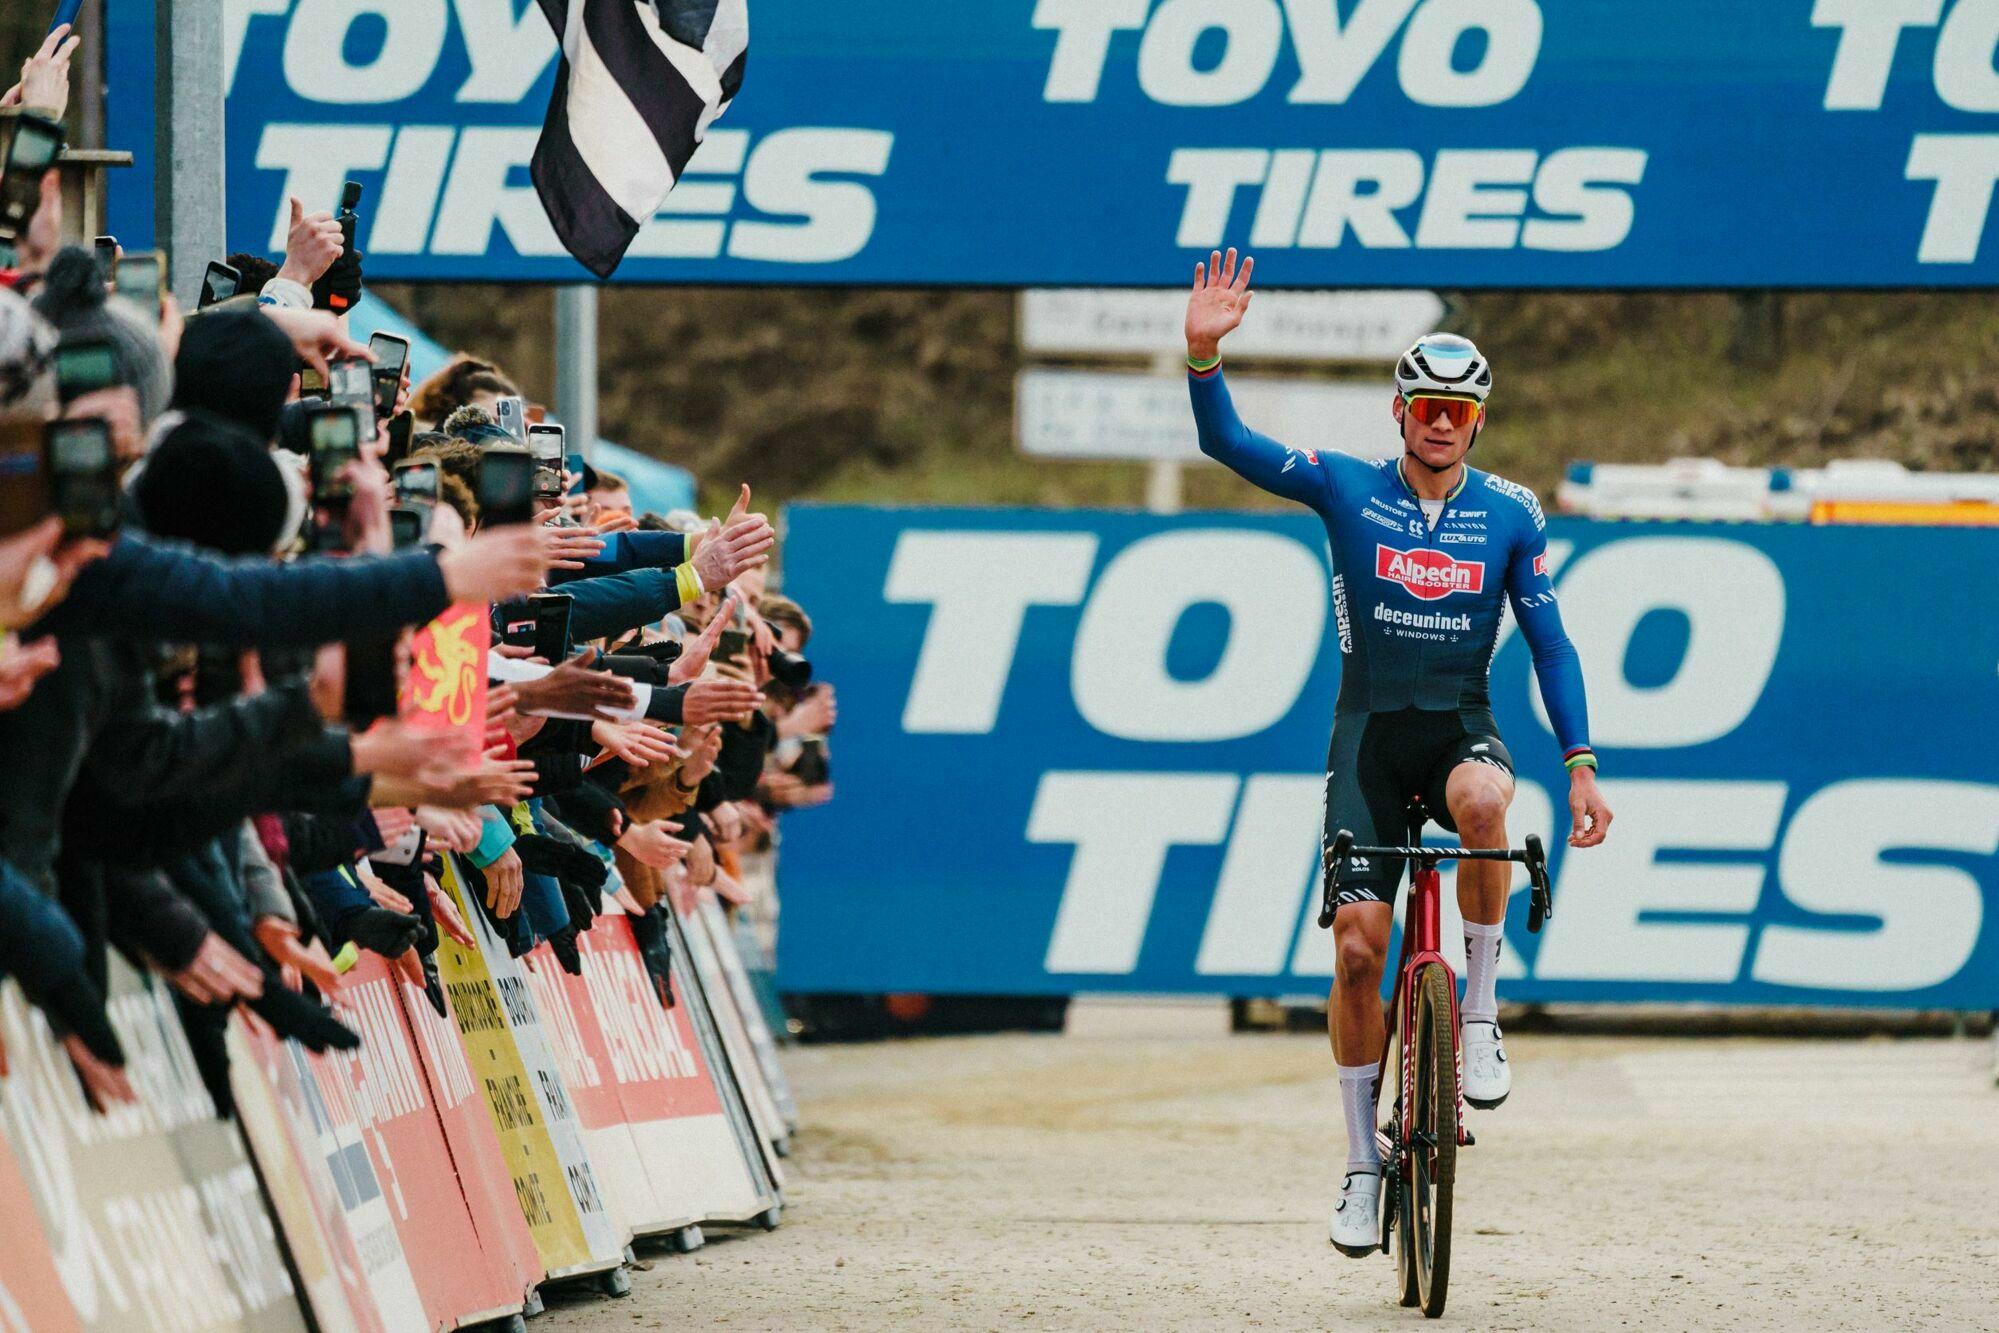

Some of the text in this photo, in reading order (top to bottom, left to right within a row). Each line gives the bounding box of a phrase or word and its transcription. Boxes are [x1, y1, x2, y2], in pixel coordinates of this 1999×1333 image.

[1032, 0, 1543, 106] TOYO
[255, 124, 893, 263] TIRES
[1166, 148, 1648, 251] TIRES
[1443, 522, 1488, 530] CANYON
[1459, 510, 1488, 518] ZWIFT
[1388, 554, 1471, 583] Alpecin
[884, 529, 1785, 748] TOO
[1332, 573, 1349, 654] Alpecin
[1374, 602, 1471, 631] deceuninck
[1396, 629, 1445, 641] WINDOWS
